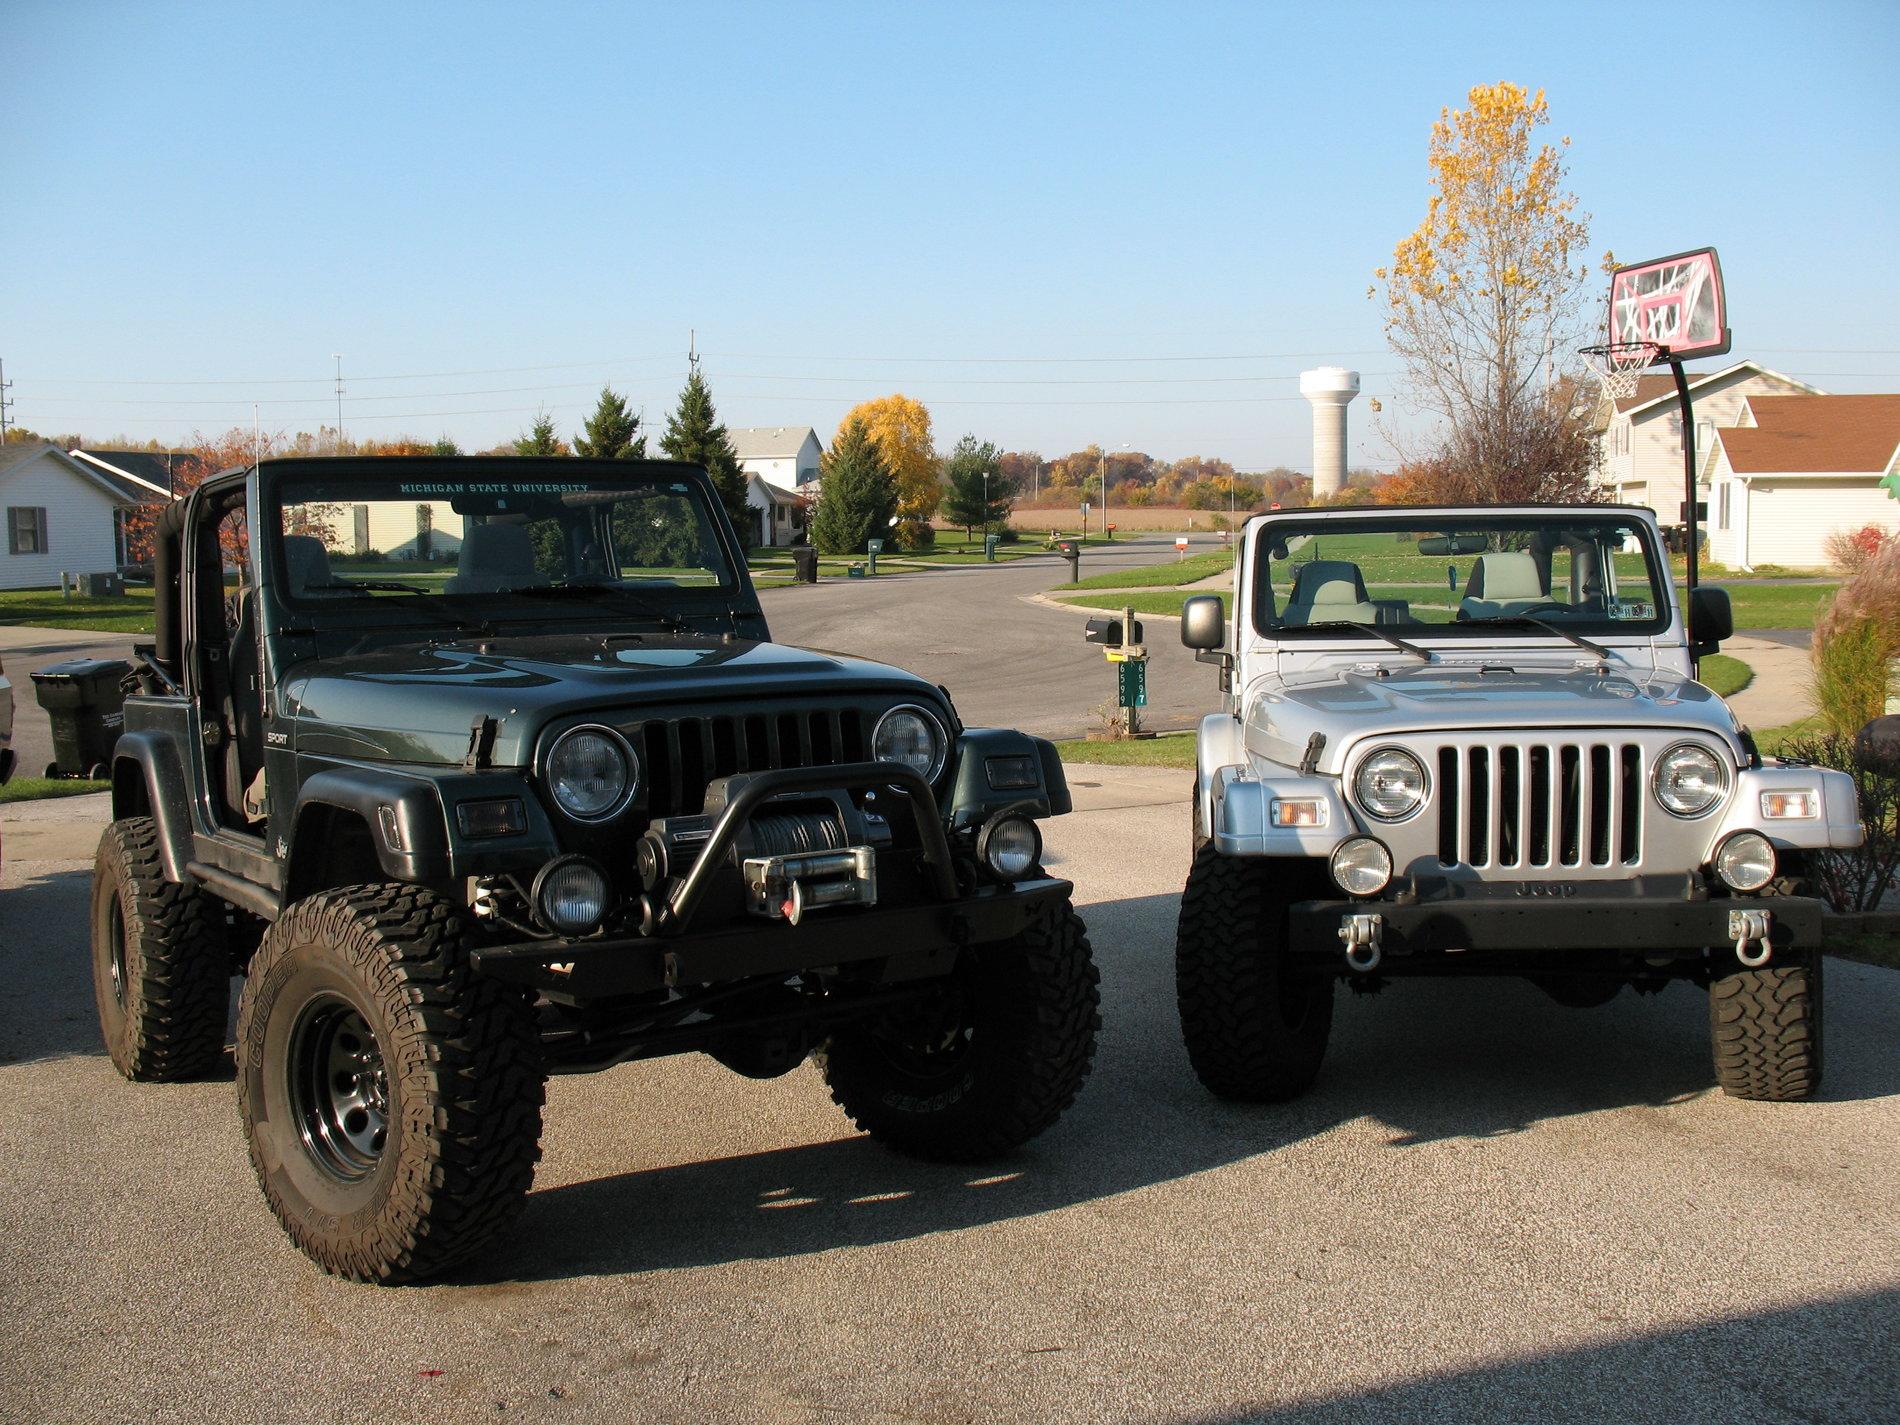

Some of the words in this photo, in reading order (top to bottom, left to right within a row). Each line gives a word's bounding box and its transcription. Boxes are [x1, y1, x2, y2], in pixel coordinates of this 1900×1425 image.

[400, 484, 464, 493] MICHIGAN
[469, 484, 509, 493] STATE
[512, 484, 589, 493] UNIVERSITY
[267, 732, 288, 744] SPORT
[250, 955, 299, 1068] COOPER
